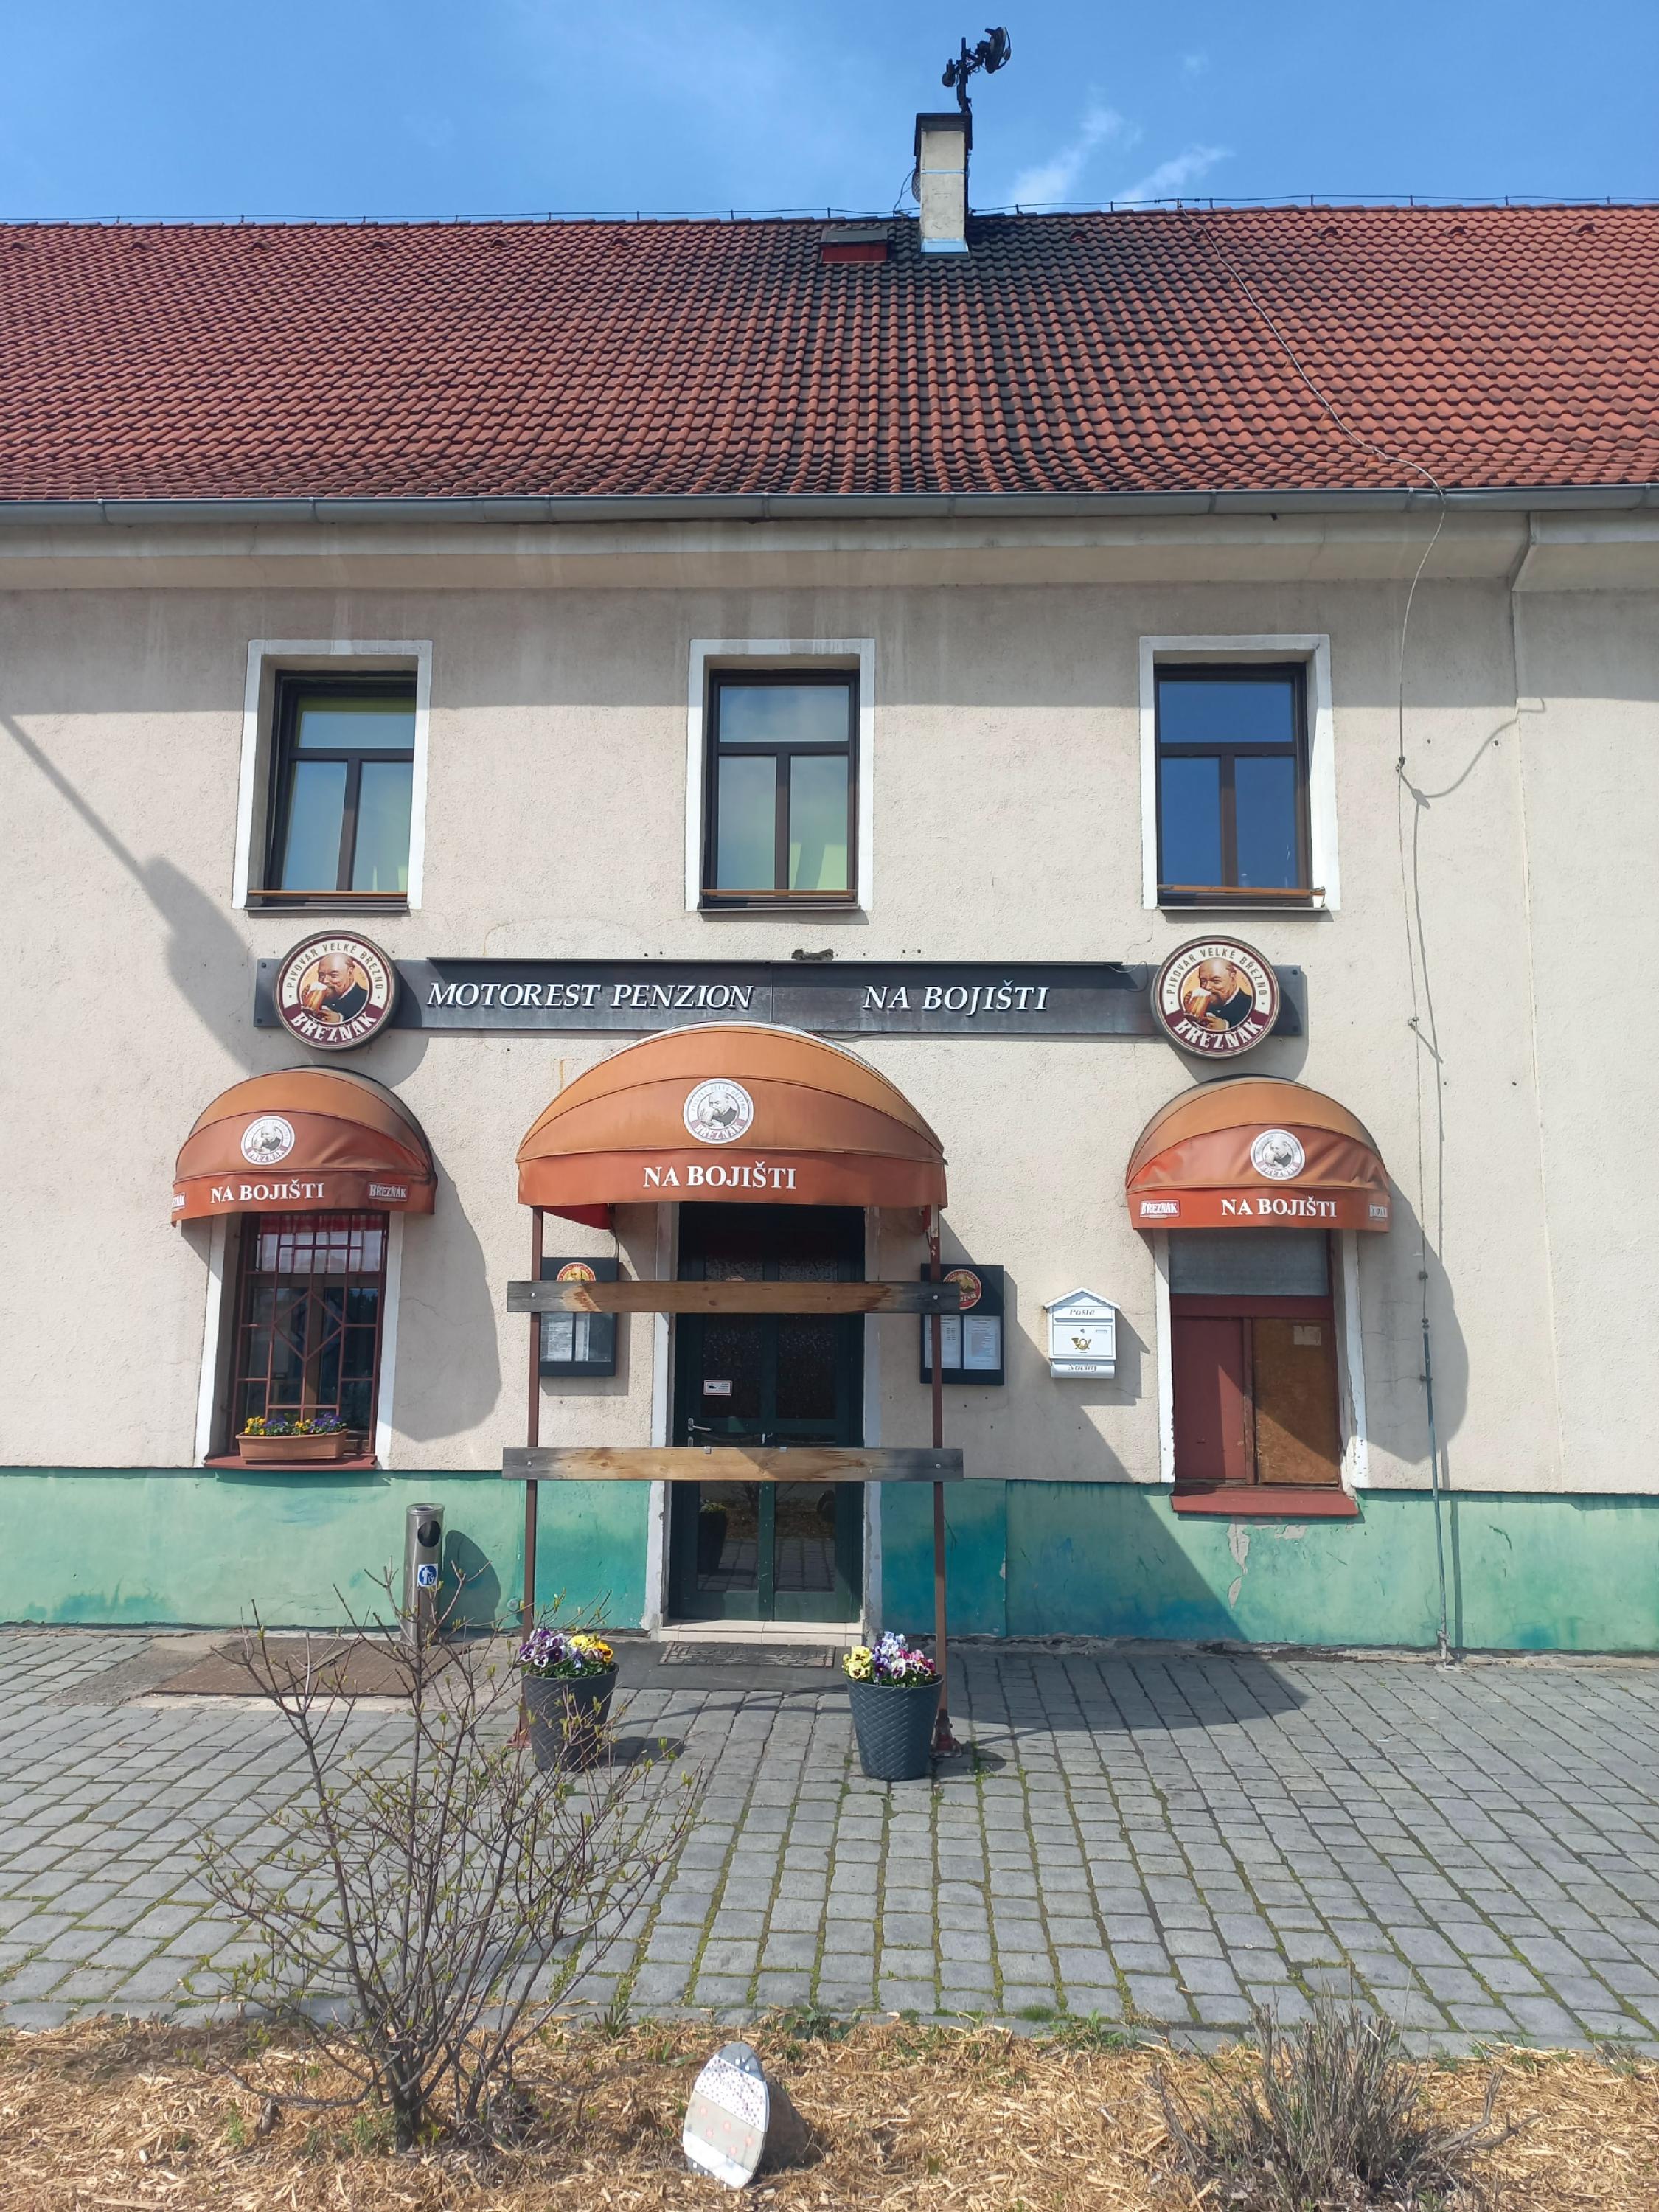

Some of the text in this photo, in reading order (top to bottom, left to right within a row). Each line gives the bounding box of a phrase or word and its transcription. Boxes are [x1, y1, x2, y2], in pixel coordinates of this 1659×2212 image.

[286, 942, 384, 990] PIVOVAR VELKÉ BŘEZNO
[1166, 947, 1267, 995] PIVOVAR VELKÉ BŘEZNO
[425, 982, 754, 1009] MOTOREST PENZION
[862, 978, 1050, 1017] NA BOJIŠTI
[642, 1160, 797, 1189] NA BOJIŠTI
[209, 1186, 234, 1204] NA
[238, 1178, 325, 1201] BOJIŠTI
[1220, 1195, 1338, 1218] NA BOJIŠTI
